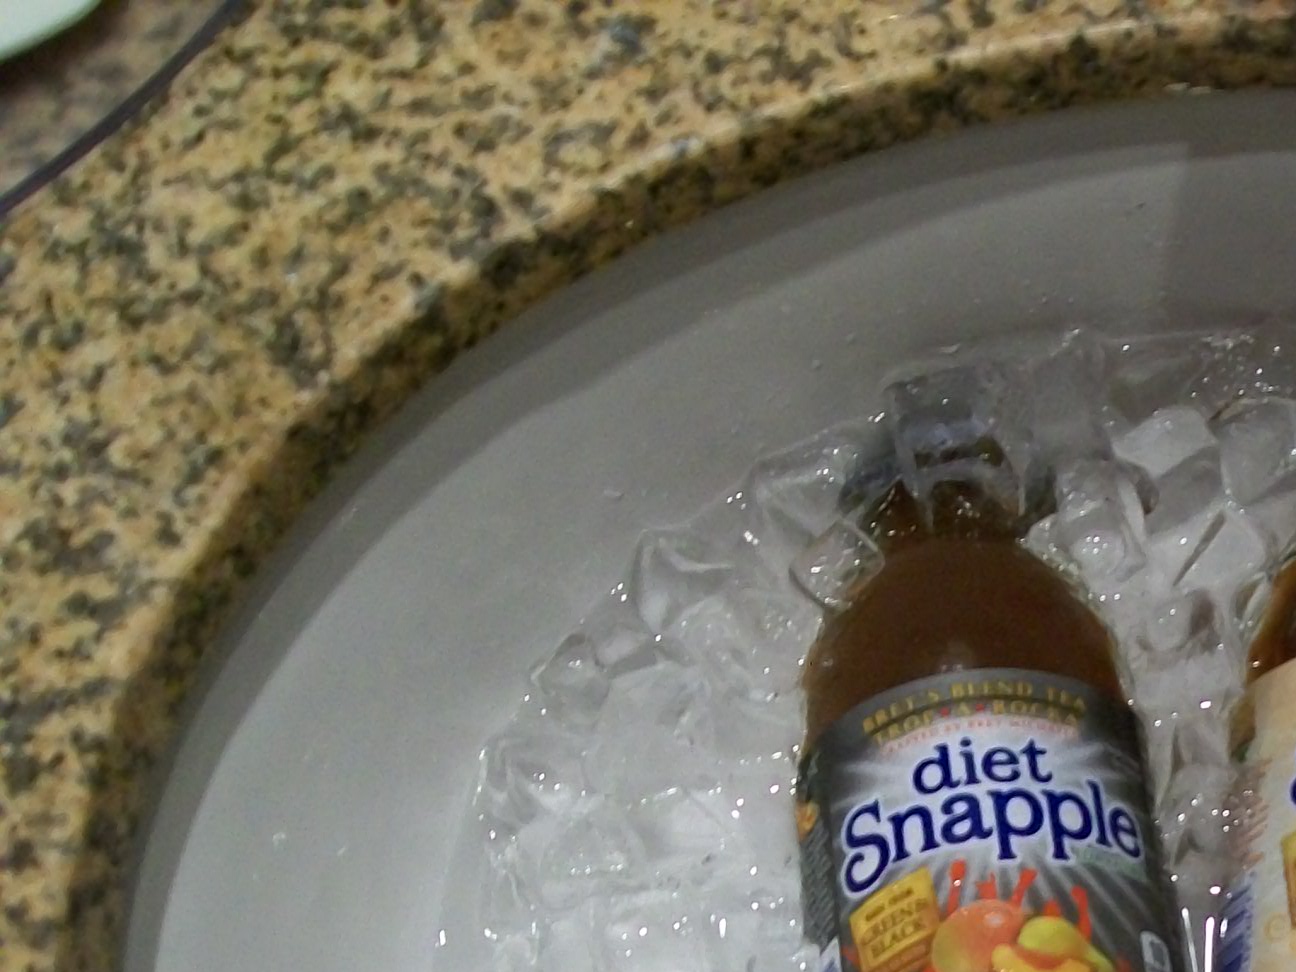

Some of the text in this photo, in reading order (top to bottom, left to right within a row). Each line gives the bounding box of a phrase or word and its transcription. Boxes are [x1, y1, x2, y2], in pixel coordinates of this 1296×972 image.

[951, 681, 1033, 698] BLEND
[913, 737, 1053, 794] diet
[845, 781, 1142, 894] Snapple
